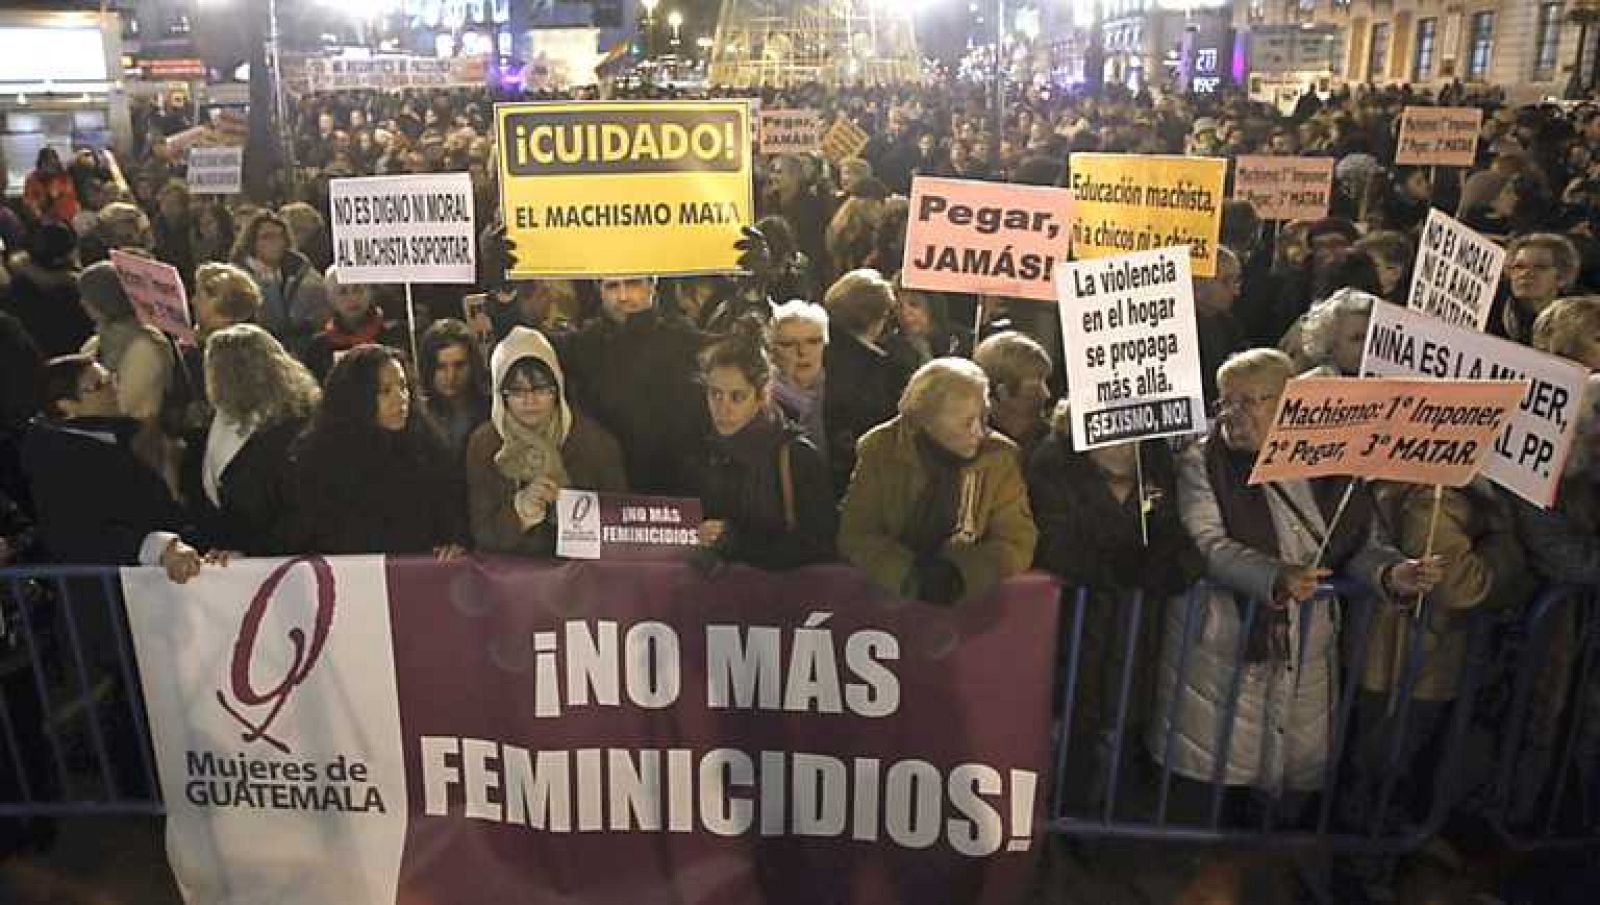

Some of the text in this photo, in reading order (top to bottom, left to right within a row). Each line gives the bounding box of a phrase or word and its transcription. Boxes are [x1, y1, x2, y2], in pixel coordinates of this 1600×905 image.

[515, 121, 735, 165] ¡CUIDADO!
[334, 193, 471, 225] NO ES DIGNO NI MORAL
[1073, 173, 1215, 216] Educación machista,
[516, 201, 740, 228] EL MACHISMO MATA
[918, 194, 1060, 239] Pegar,
[338, 238, 353, 267] AL
[354, 236, 408, 266] MACHISTA
[1084, 223, 1091, 245] a
[1096, 218, 1134, 250] chicos
[1138, 225, 1150, 251] ni
[1425, 218, 1443, 251] NO
[1444, 228, 1457, 258] ES
[913, 244, 1055, 283] JAMÁS!
[1074, 254, 1176, 298] La violencia
[1421, 250, 1438, 283] NI
[1435, 260, 1449, 289] ES
[1083, 297, 1176, 333] en el hogar
[1086, 333, 1178, 370] se propaga
[1368, 323, 1416, 371] NIÑA
[1420, 341, 1450, 379] ES
[1098, 365, 1173, 403] más allá.
[1162, 400, 1189, 428] NO!
[1276, 397, 1384, 428] Machismo:
[1411, 397, 1504, 434] Imponer,
[1288, 440, 1347, 466] Pegar,
[1390, 436, 1478, 466] MATAR.
[1518, 433, 1554, 478] PP.
[622, 505, 682, 524] ¡NO MÁS
[533, 612, 901, 719] ¡NO MÁS
[185, 752, 367, 783] Mujeres de
[185, 782, 386, 813] GUATEMALA
[420, 735, 1038, 858] FEMINICIDIOS!
